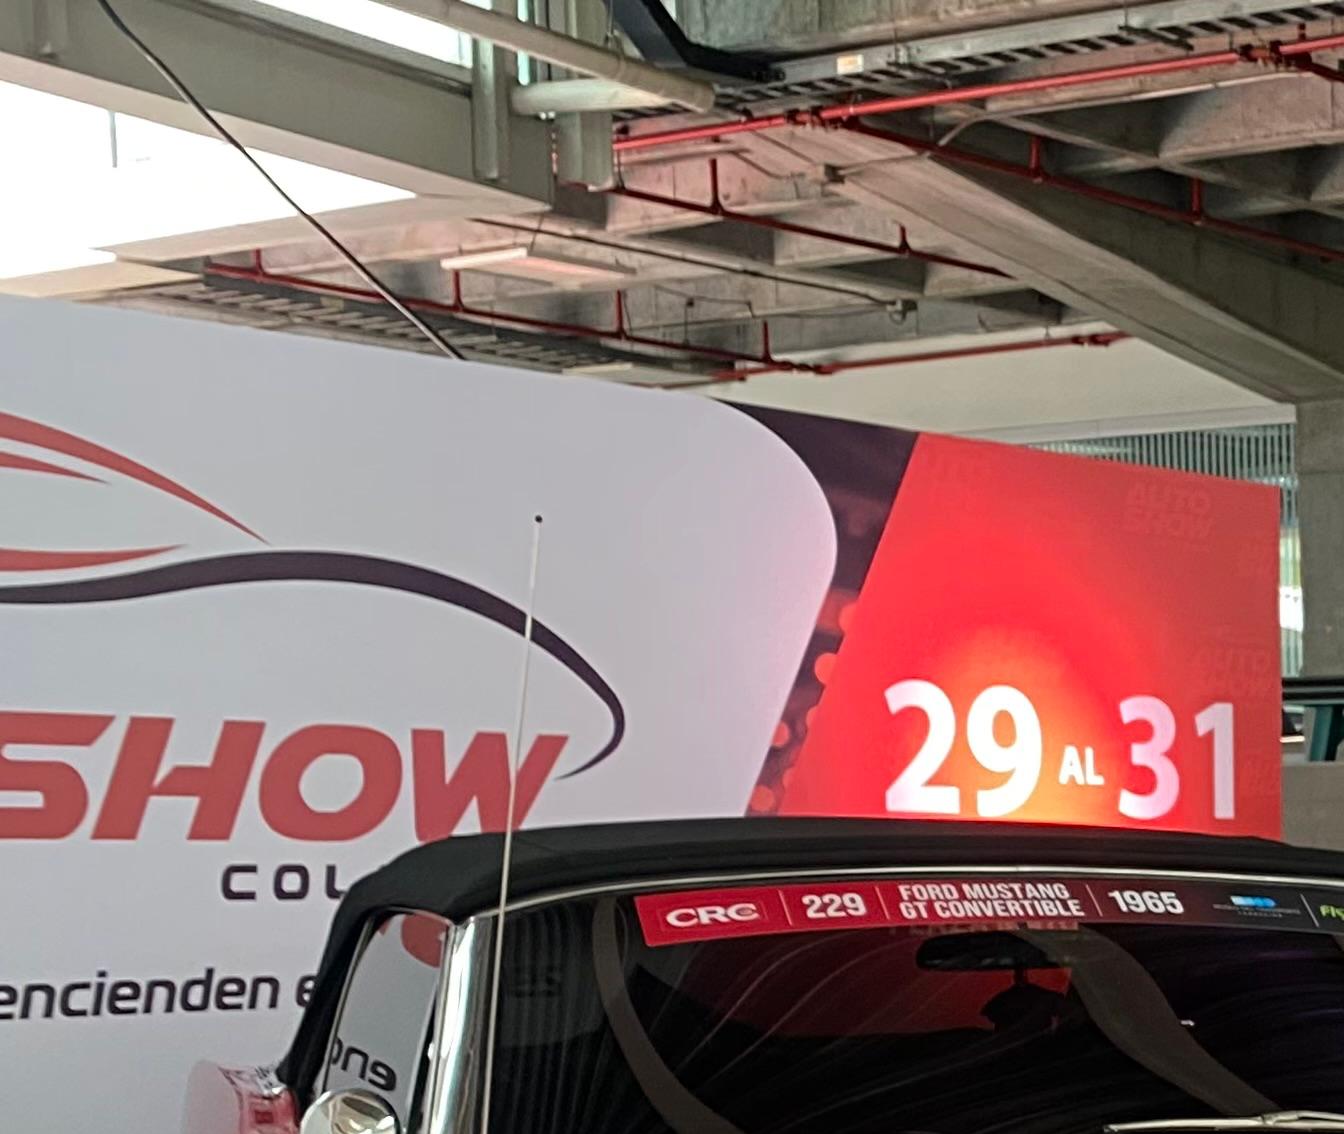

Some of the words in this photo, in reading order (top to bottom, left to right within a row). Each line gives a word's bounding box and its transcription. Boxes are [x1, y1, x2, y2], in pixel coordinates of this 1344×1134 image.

[884, 679, 1042, 817] 29
[1059, 745, 1104, 785] AL
[1118, 695, 1234, 820] 31
[899, 884, 959, 901] FORD
[963, 884, 1069, 900] MUSTANG
[1108, 890, 1184, 915] 1965
[666, 902, 759, 927] CRC
[802, 893, 867, 919] 229
[901, 902, 930, 919] GT
[935, 898, 1085, 918] CONVERTIBLE
[0, 968, 280, 1019] encienden
